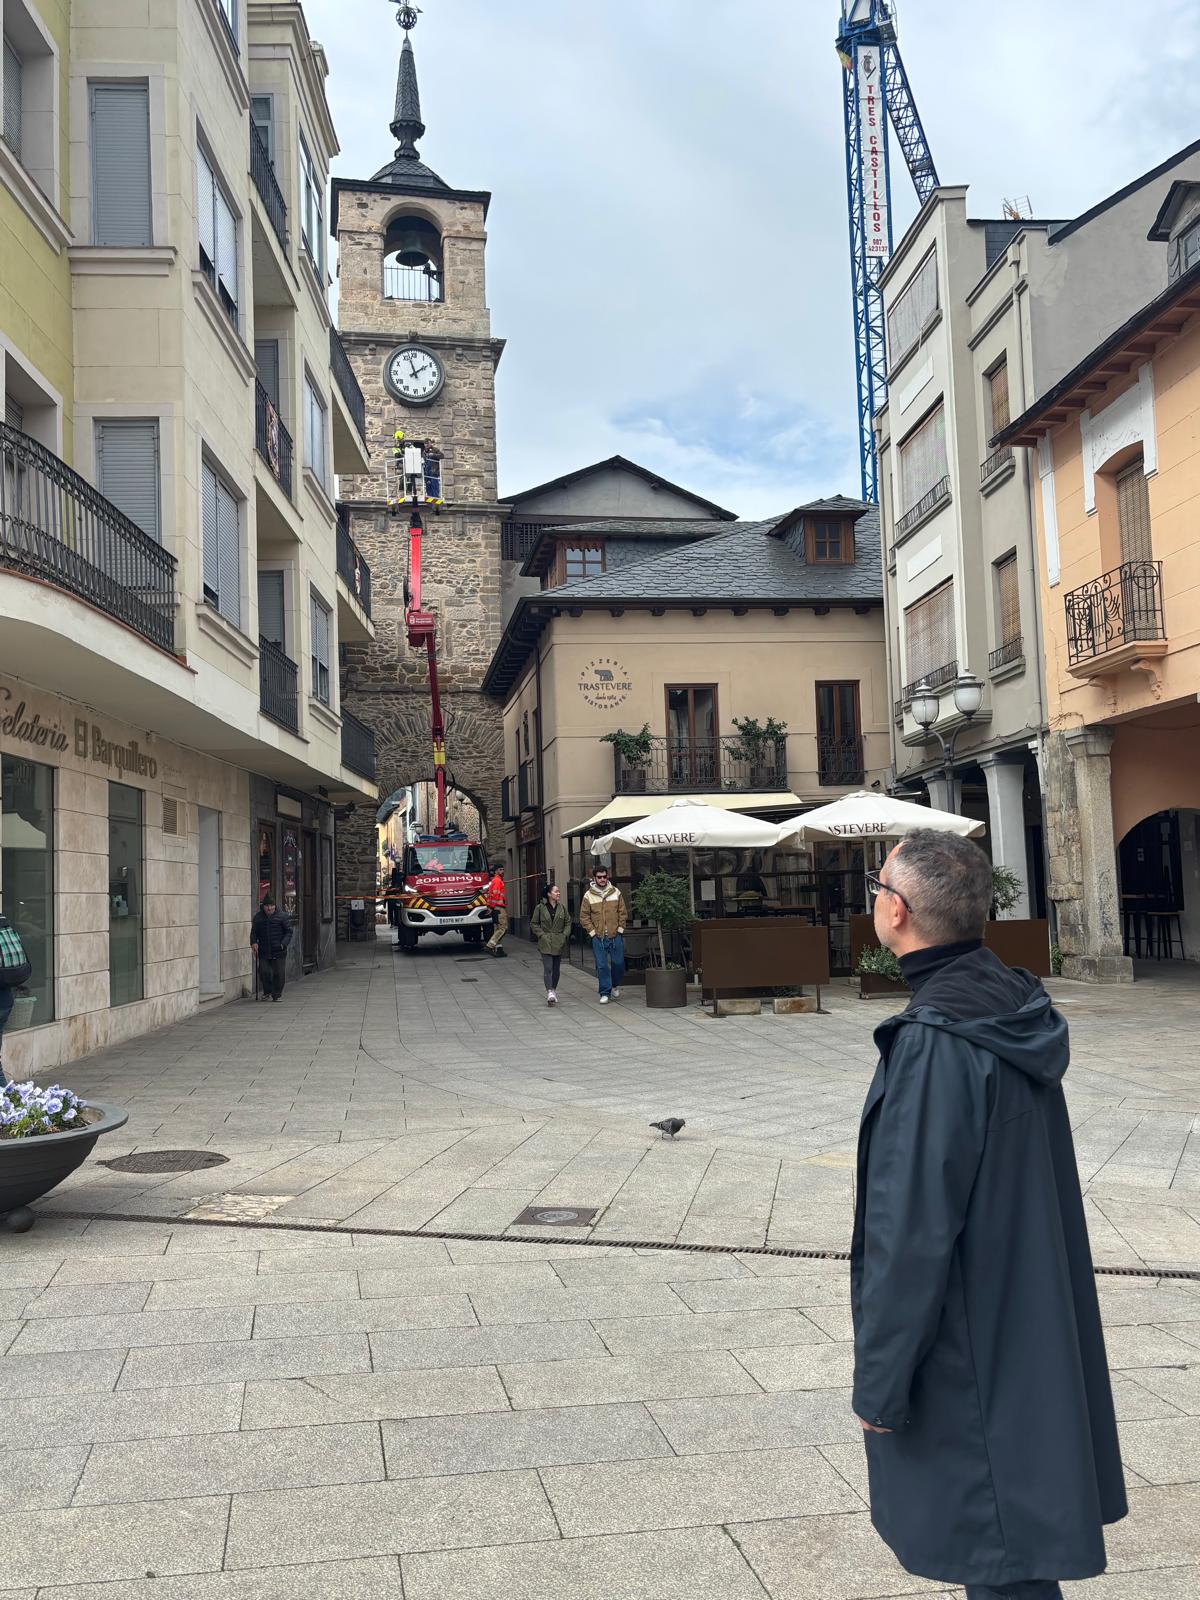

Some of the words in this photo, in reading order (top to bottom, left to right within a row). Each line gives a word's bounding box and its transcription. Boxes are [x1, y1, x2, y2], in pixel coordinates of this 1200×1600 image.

[867, 85, 876, 127] TRES
[869, 136, 881, 232] CASTILLOS
[578, 682, 632, 691] TRASTEVERE
[584, 695, 626, 709] RISTORANTE
[75, 718, 88, 758] El
[92, 725, 158, 779] Barquillero
